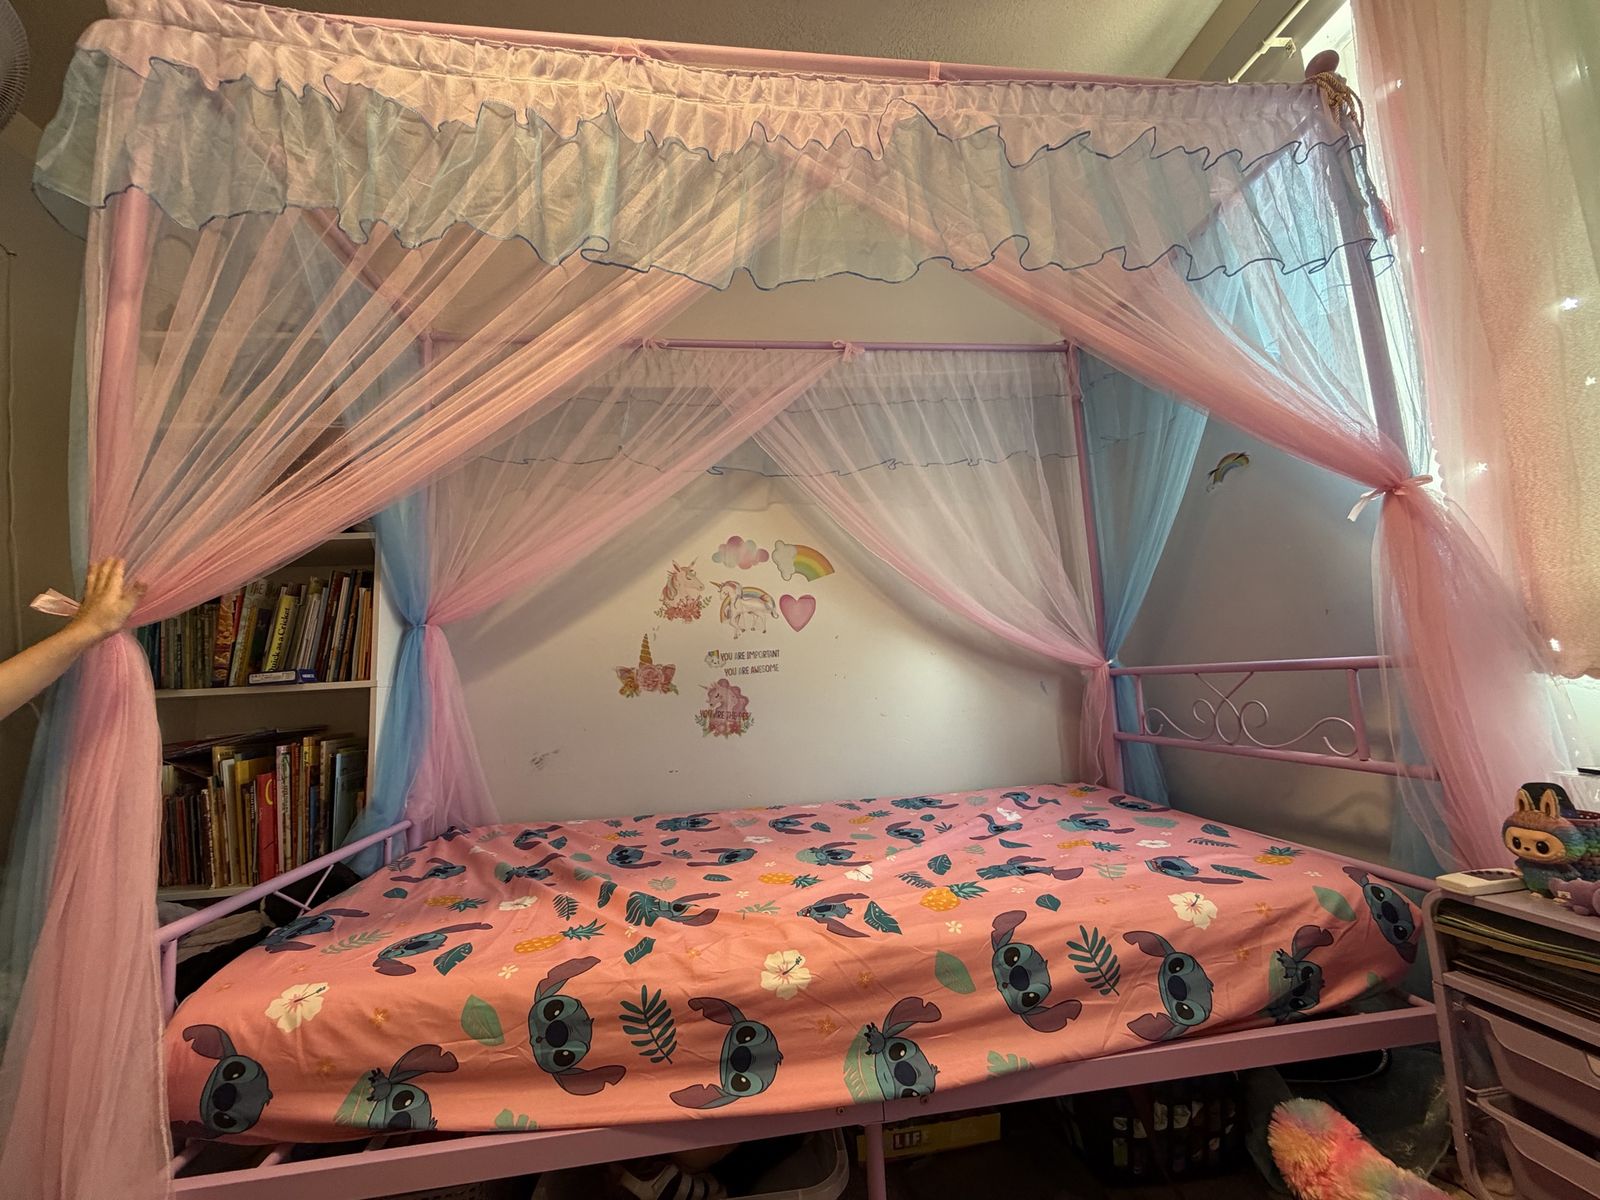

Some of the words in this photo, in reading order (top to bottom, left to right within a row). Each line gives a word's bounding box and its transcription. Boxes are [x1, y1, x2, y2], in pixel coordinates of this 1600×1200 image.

[278, 608, 290, 636] Cricket
[720, 652, 733, 661] YOU
[735, 651, 745, 660] ARE
[746, 649, 780, 660] IMPORTANT
[724, 667, 737, 676] YOU
[739, 665, 749, 675] ARE
[750, 664, 779, 674] AWESOME
